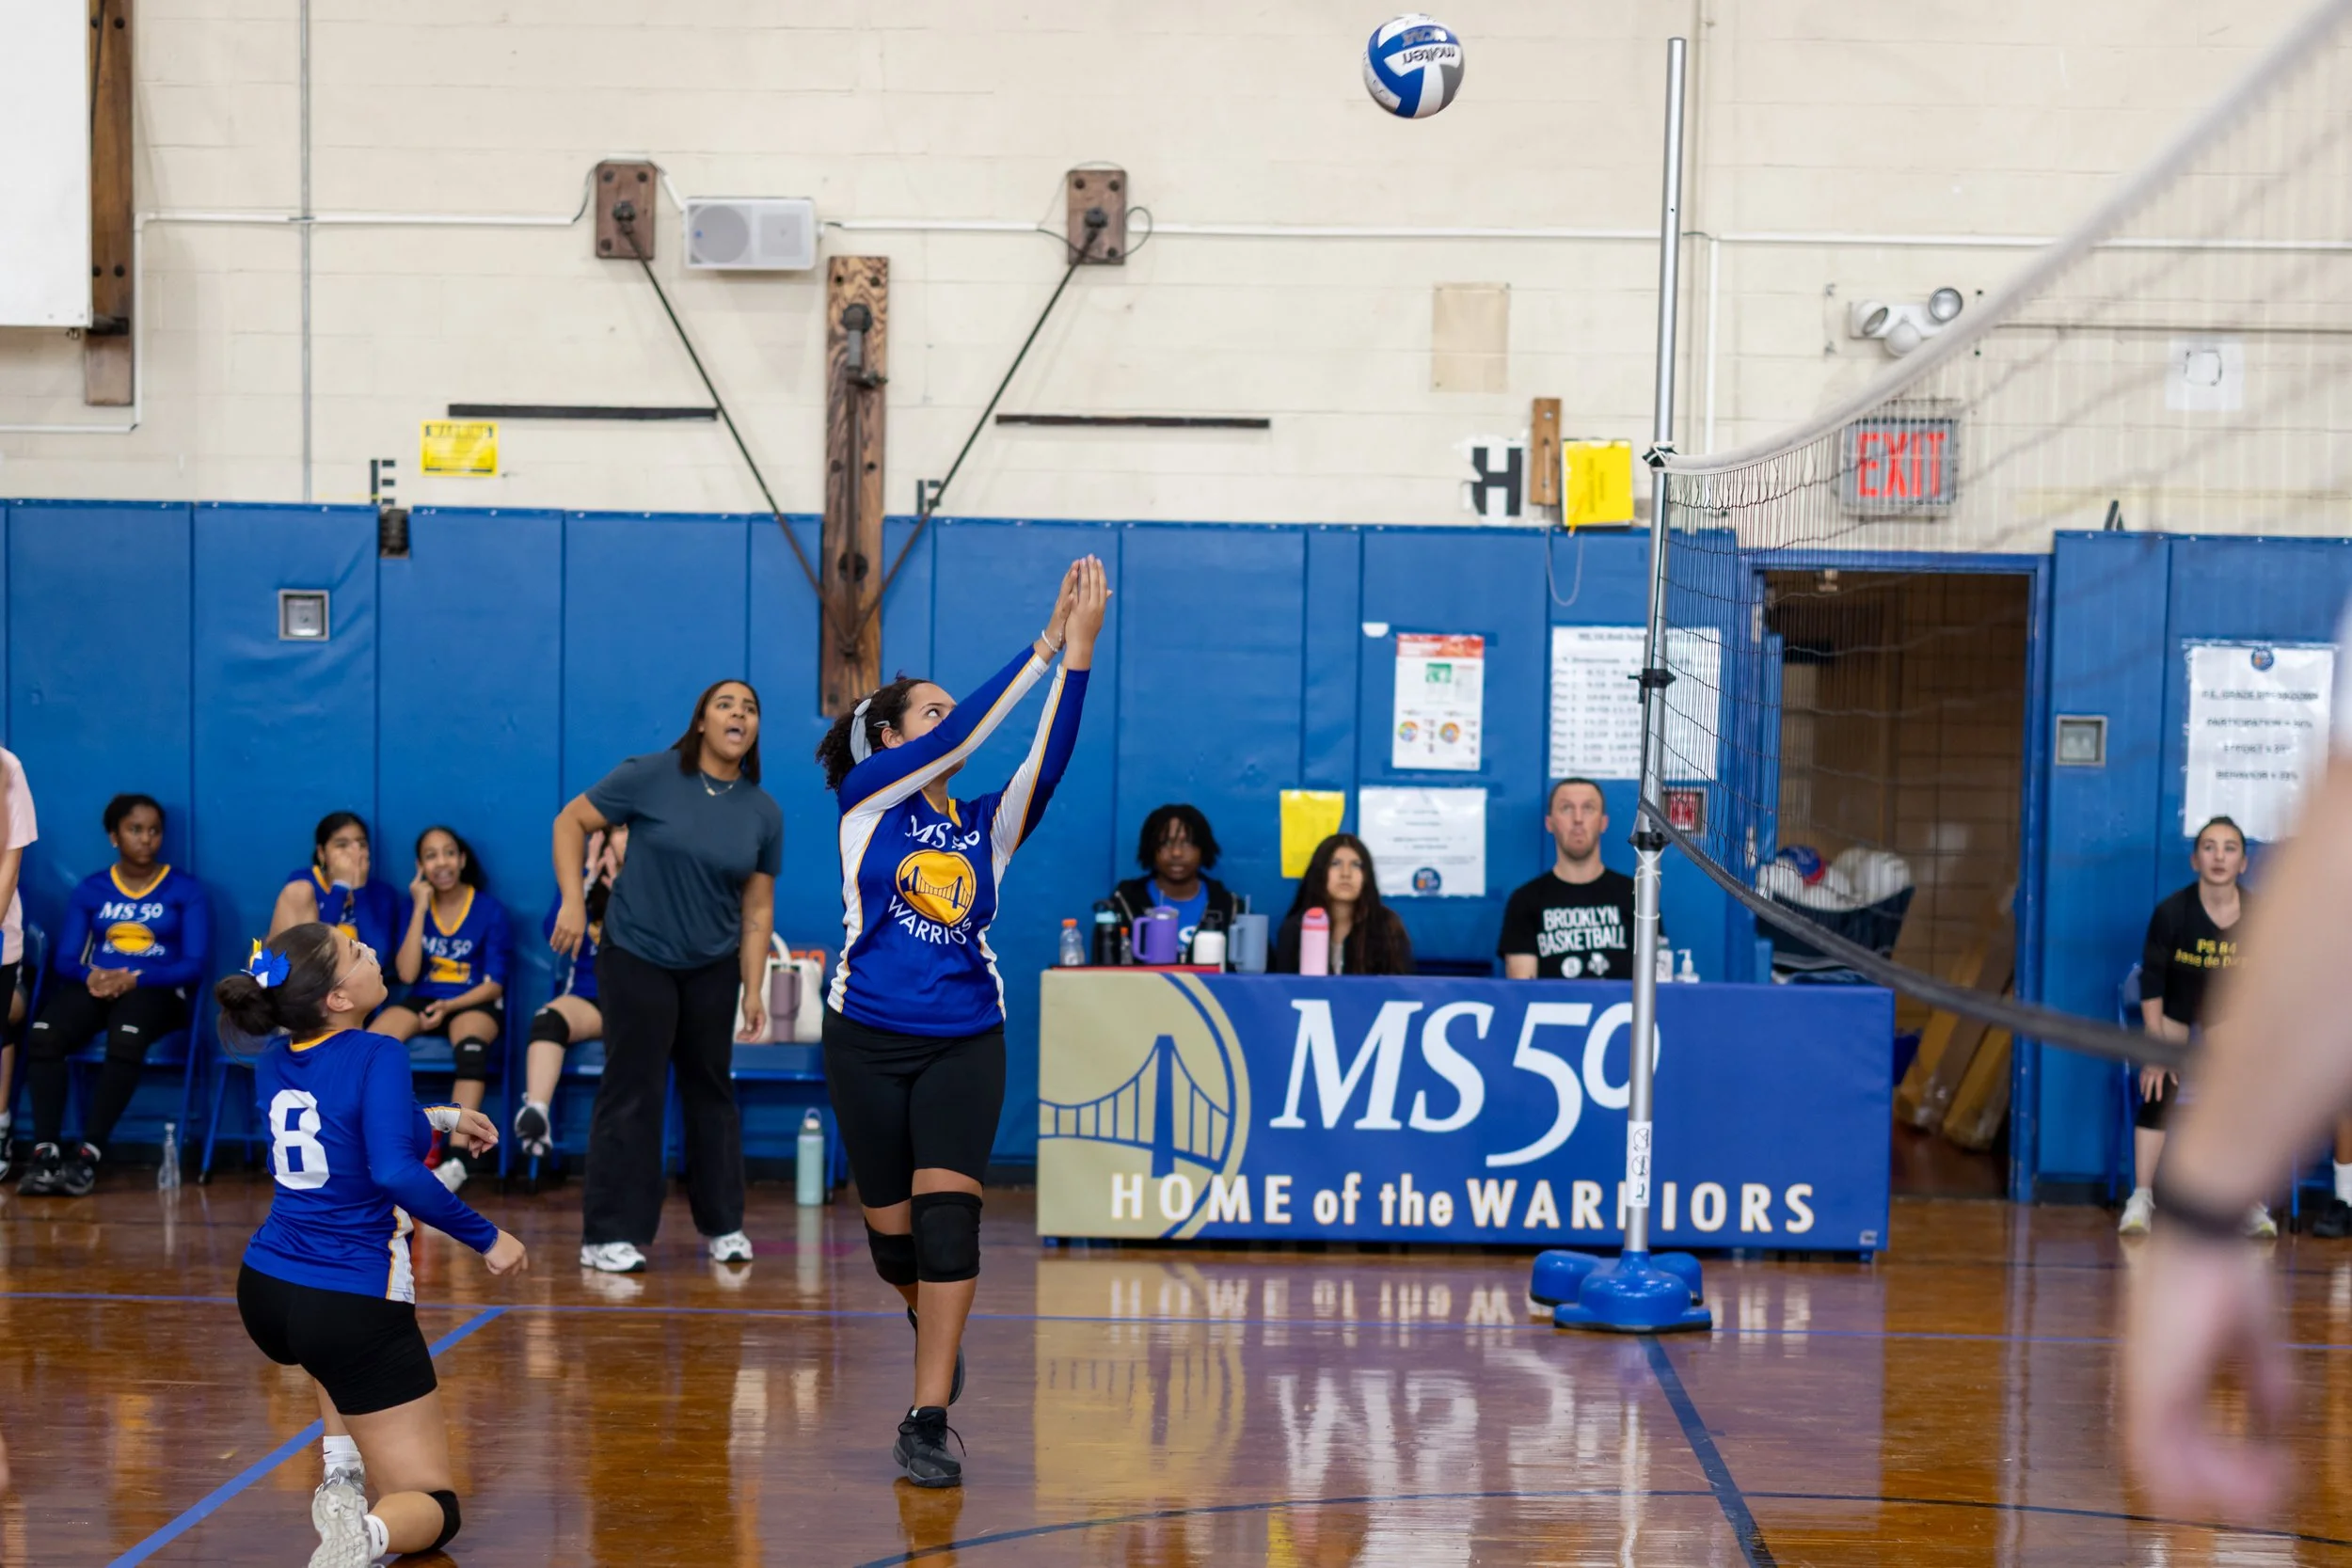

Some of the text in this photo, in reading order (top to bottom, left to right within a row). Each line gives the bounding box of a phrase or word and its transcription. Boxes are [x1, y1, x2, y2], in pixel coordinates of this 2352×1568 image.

[371, 460, 395, 506] E
[1471, 447, 1522, 516] H
[1858, 431, 1946, 498] EXIT
[904, 815, 953, 849] MS
[98, 901, 165, 923] MS 50
[1542, 905, 1621, 932] BROOKLYN
[448, 939, 473, 960] 50
[1536, 925, 1628, 958] BASKETBALL
[1269, 999, 1661, 1167] MS 50
[268, 1088, 331, 1191] 8
[1110, 1171, 1816, 1234] HOME of the WARIORS
